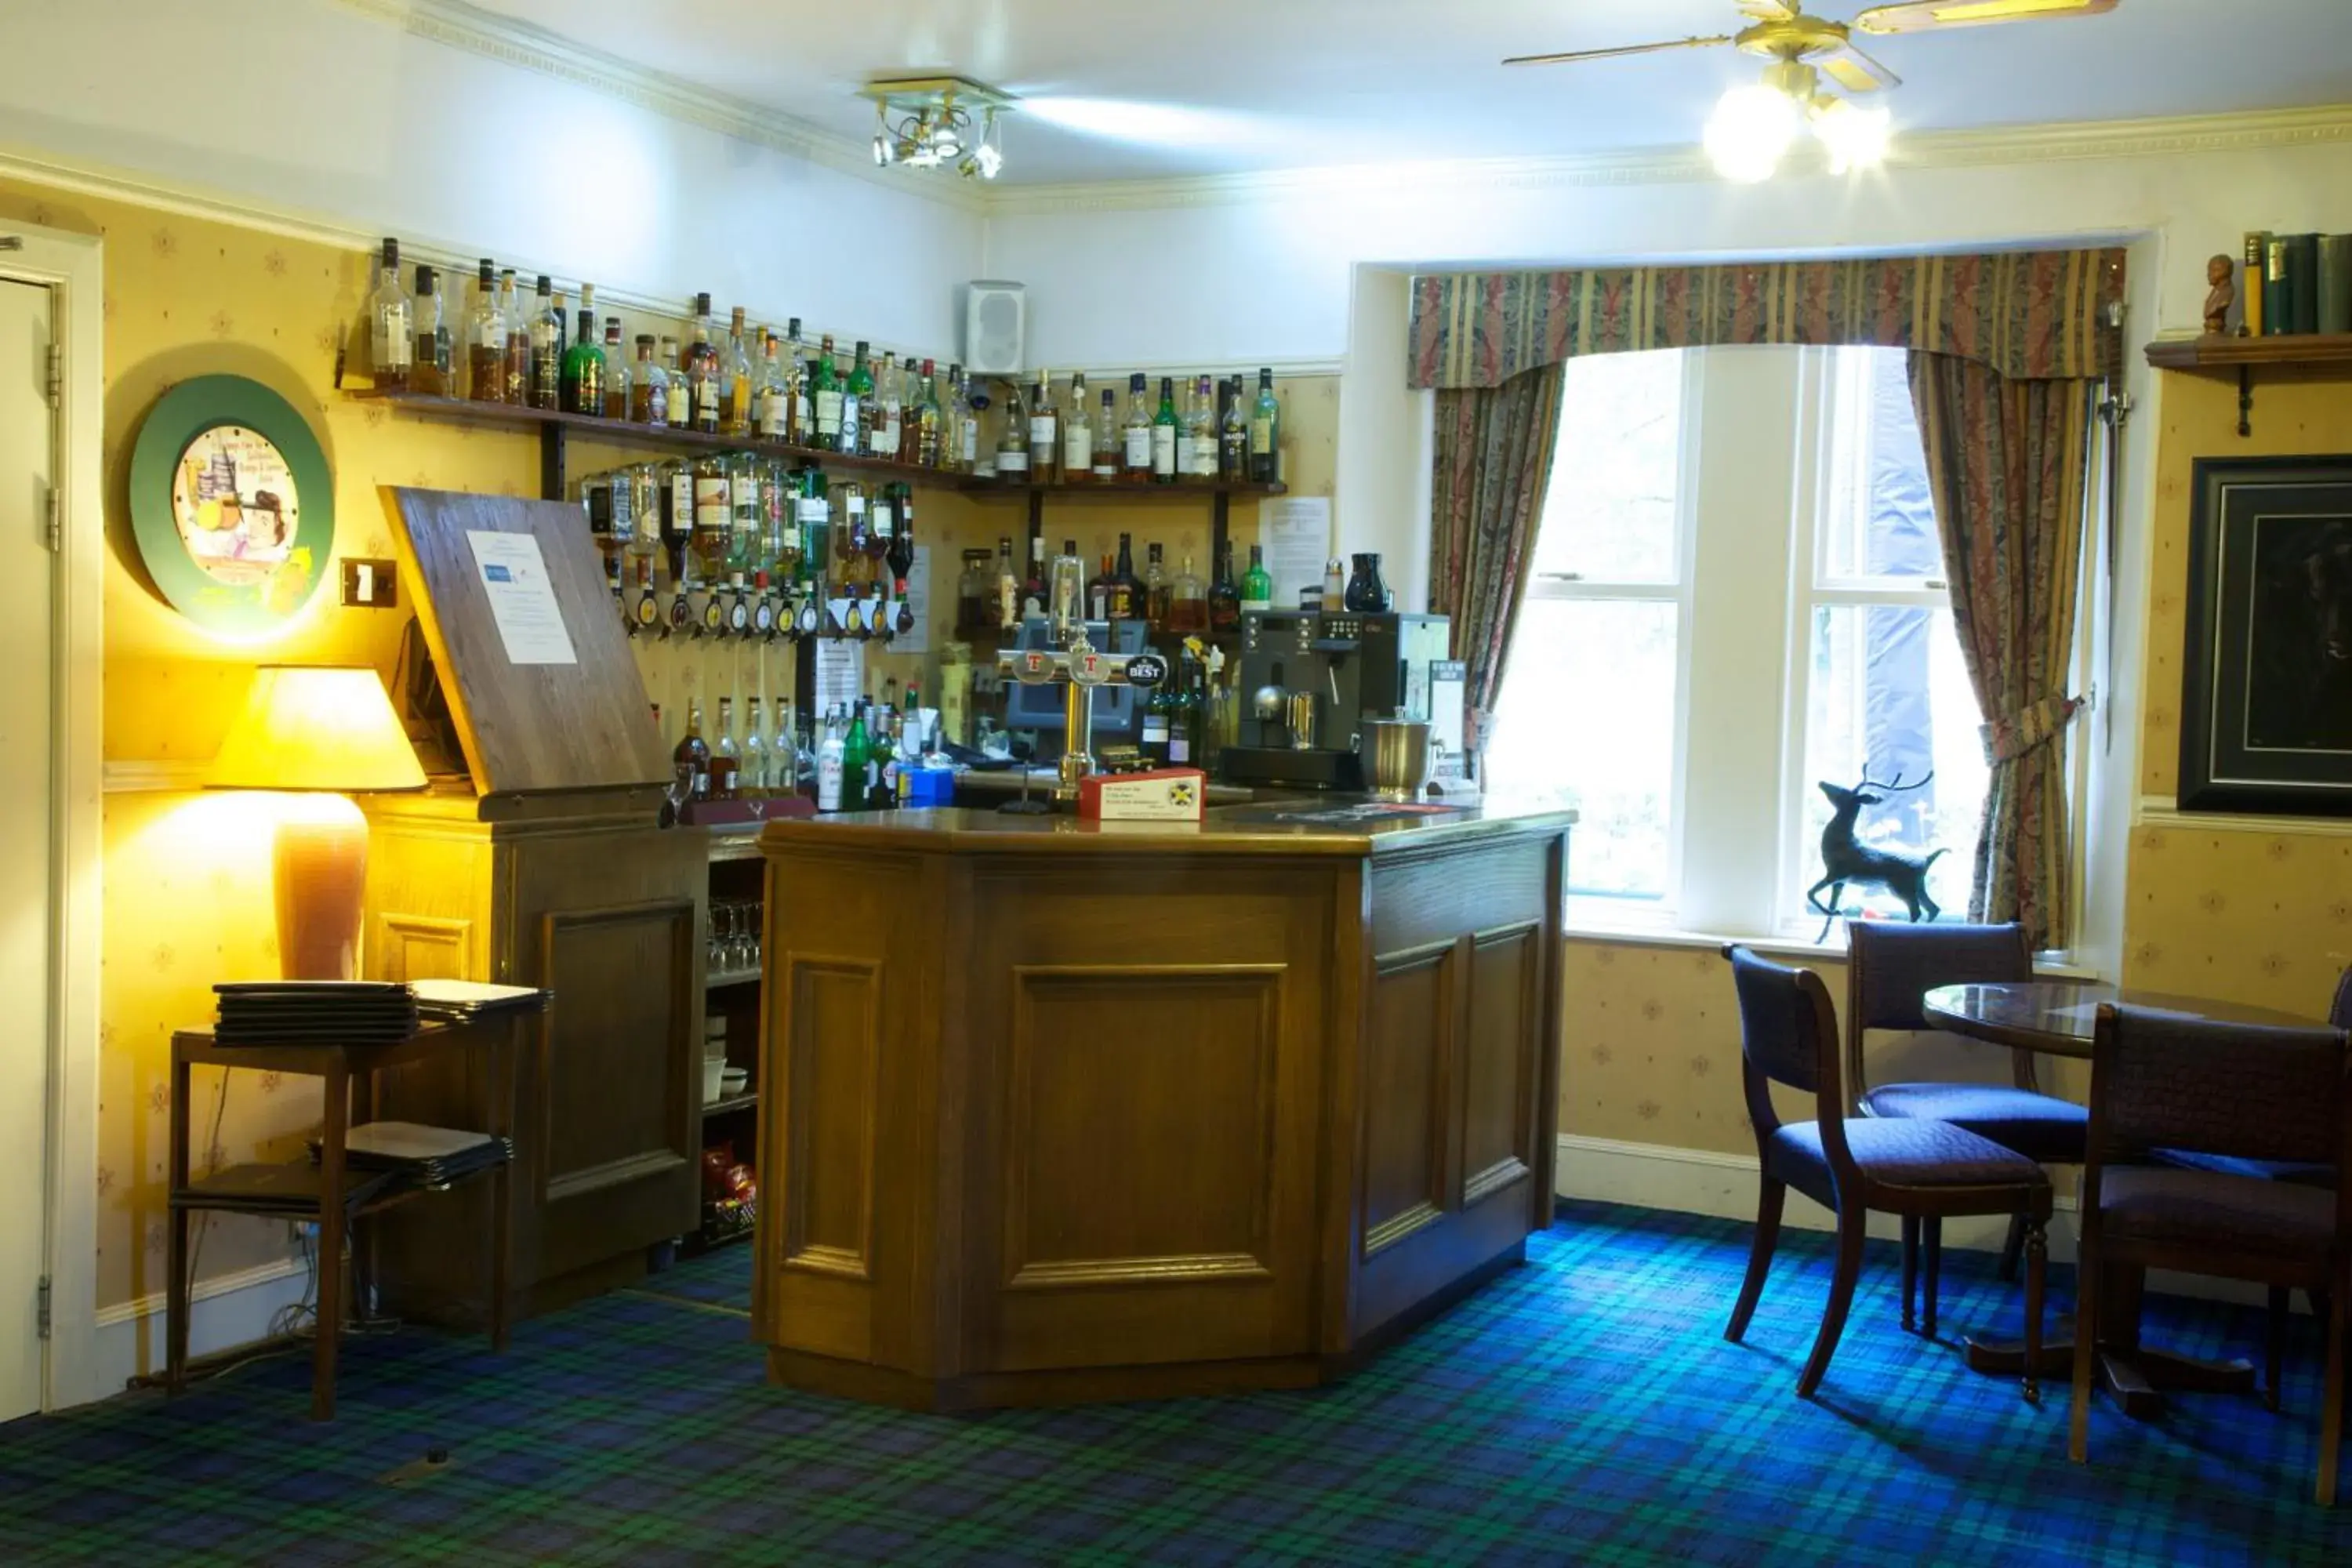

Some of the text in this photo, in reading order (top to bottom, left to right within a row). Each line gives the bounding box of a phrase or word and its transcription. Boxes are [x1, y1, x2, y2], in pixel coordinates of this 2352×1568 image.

[1028, 654, 1043, 671] T
[1084, 655, 1097, 672] T
[1130, 667, 1160, 678] BEST
